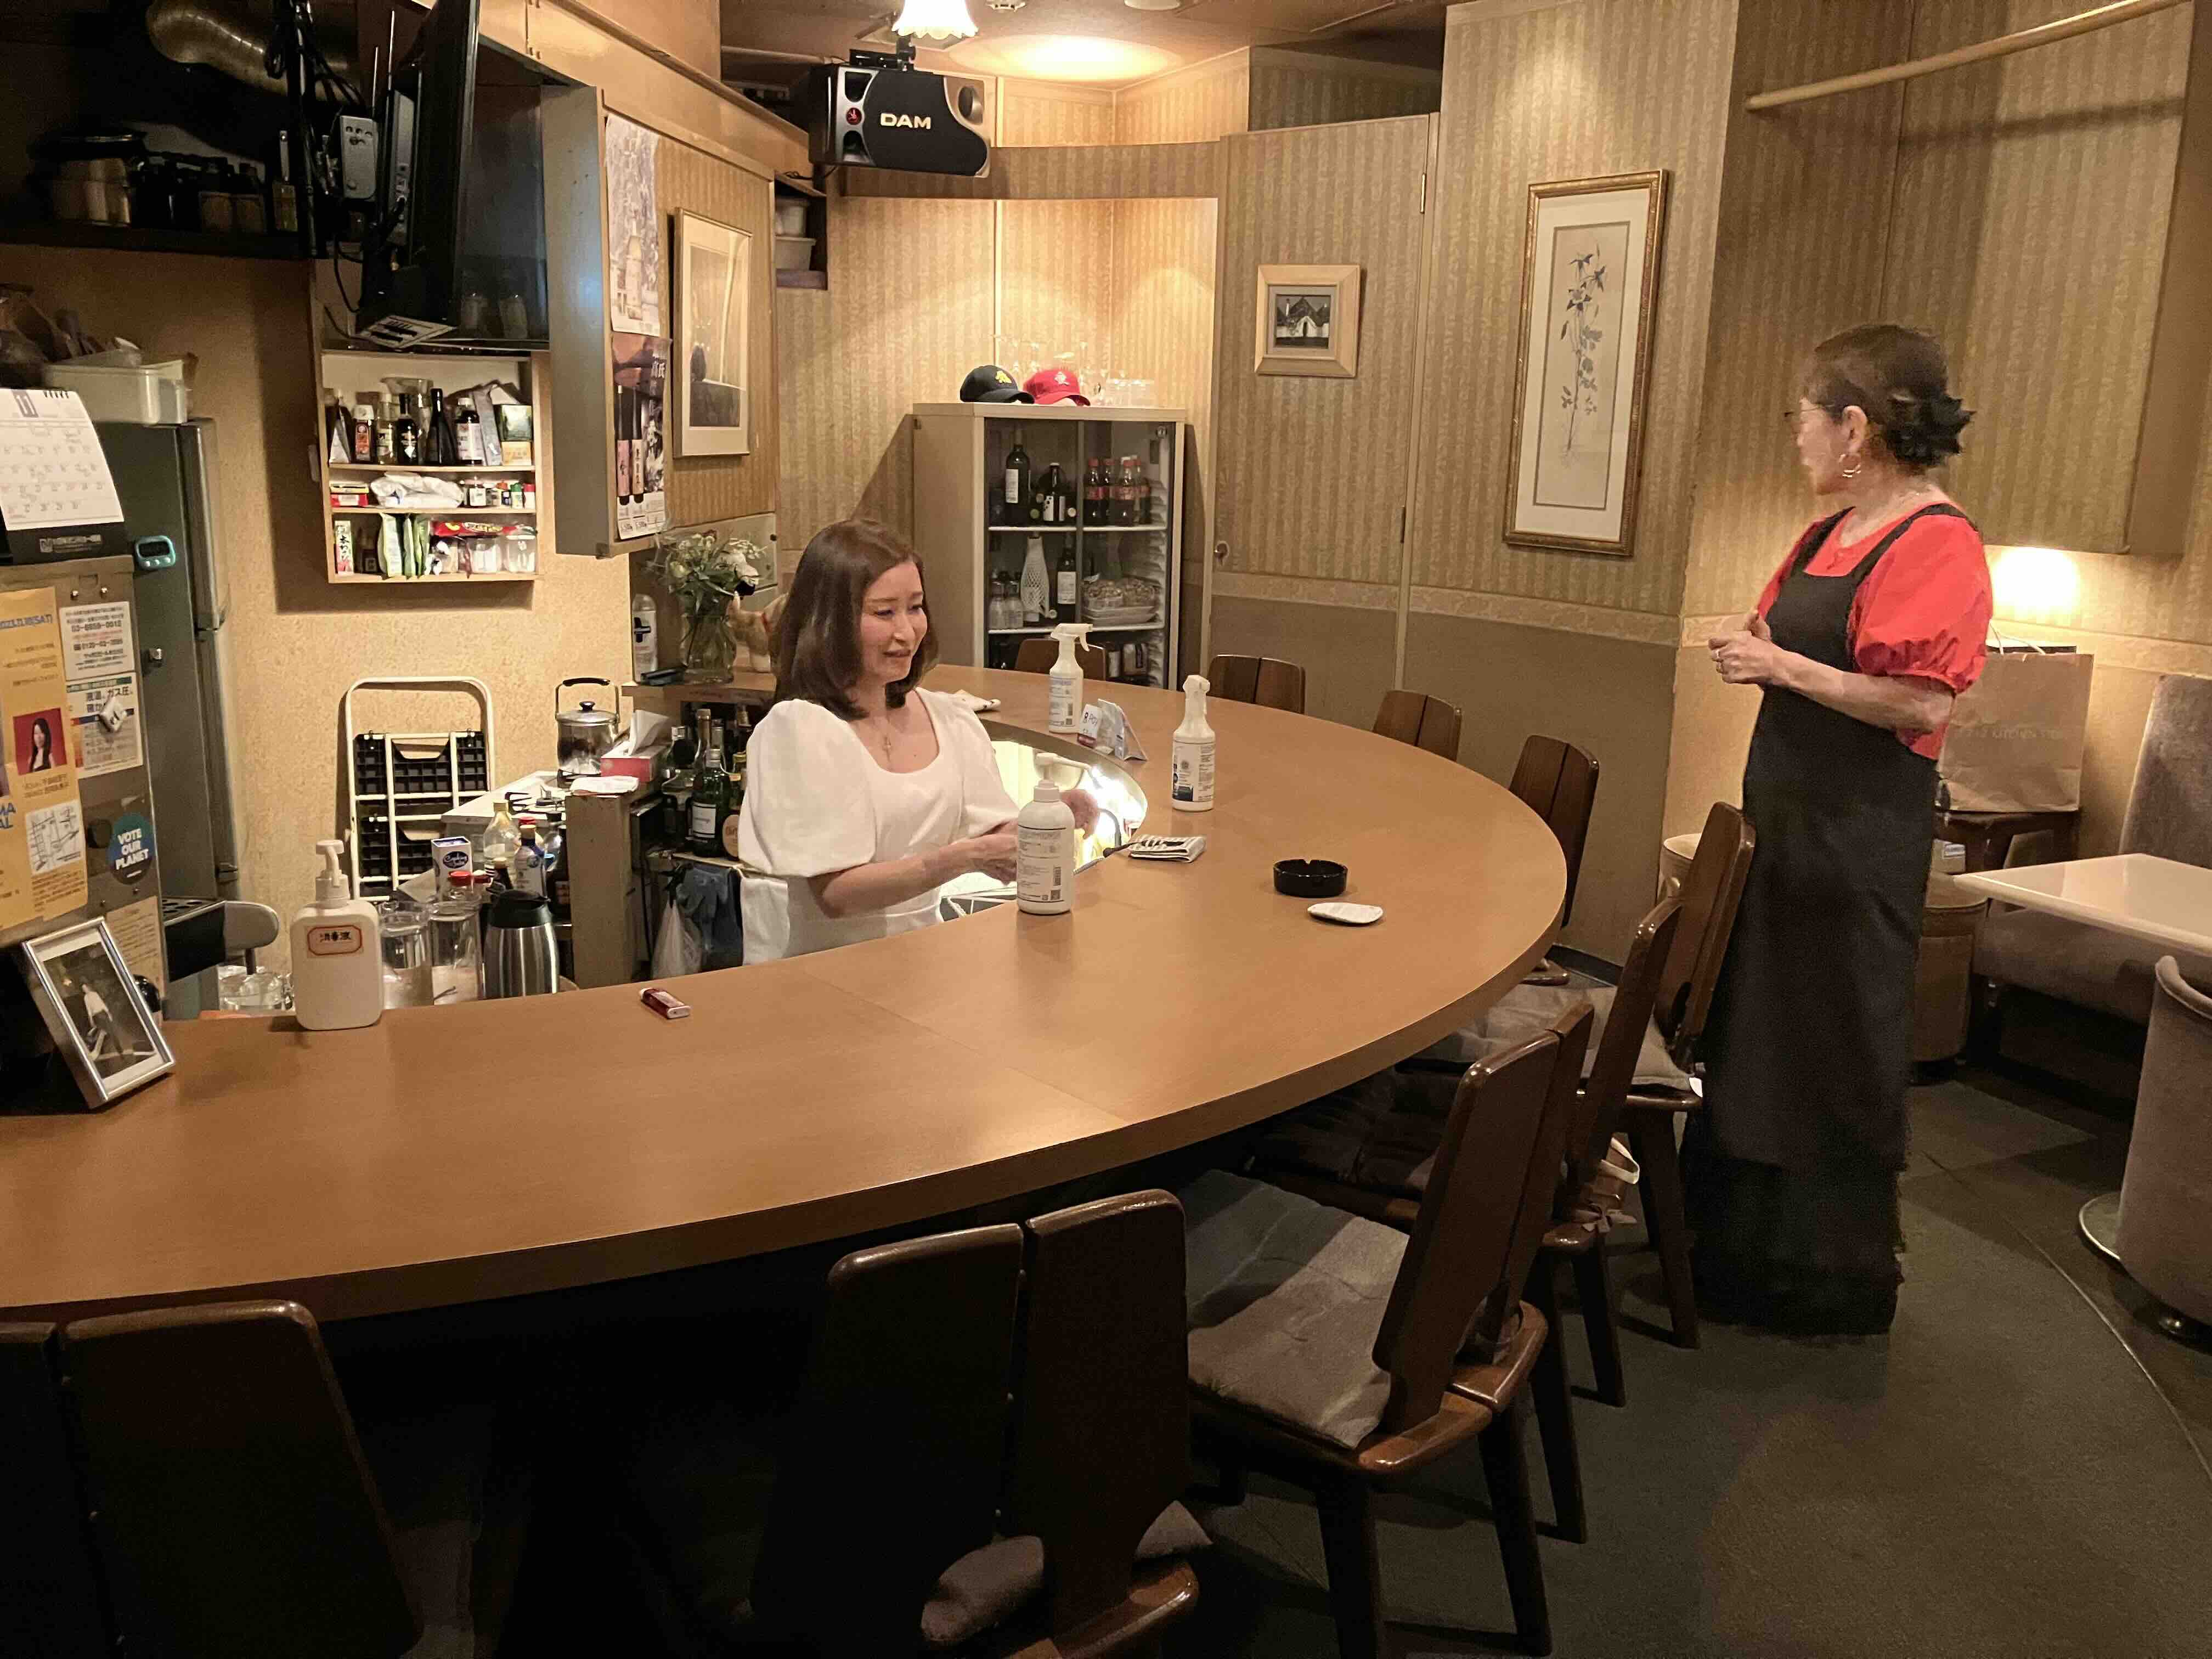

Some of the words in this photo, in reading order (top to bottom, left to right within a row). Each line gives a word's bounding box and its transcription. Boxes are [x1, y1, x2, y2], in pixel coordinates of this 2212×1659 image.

[880, 113, 931, 129] DAM
[117, 828, 142, 845] VOTE
[122, 840, 141, 856] OUR
[116, 848, 149, 870] PLANET
